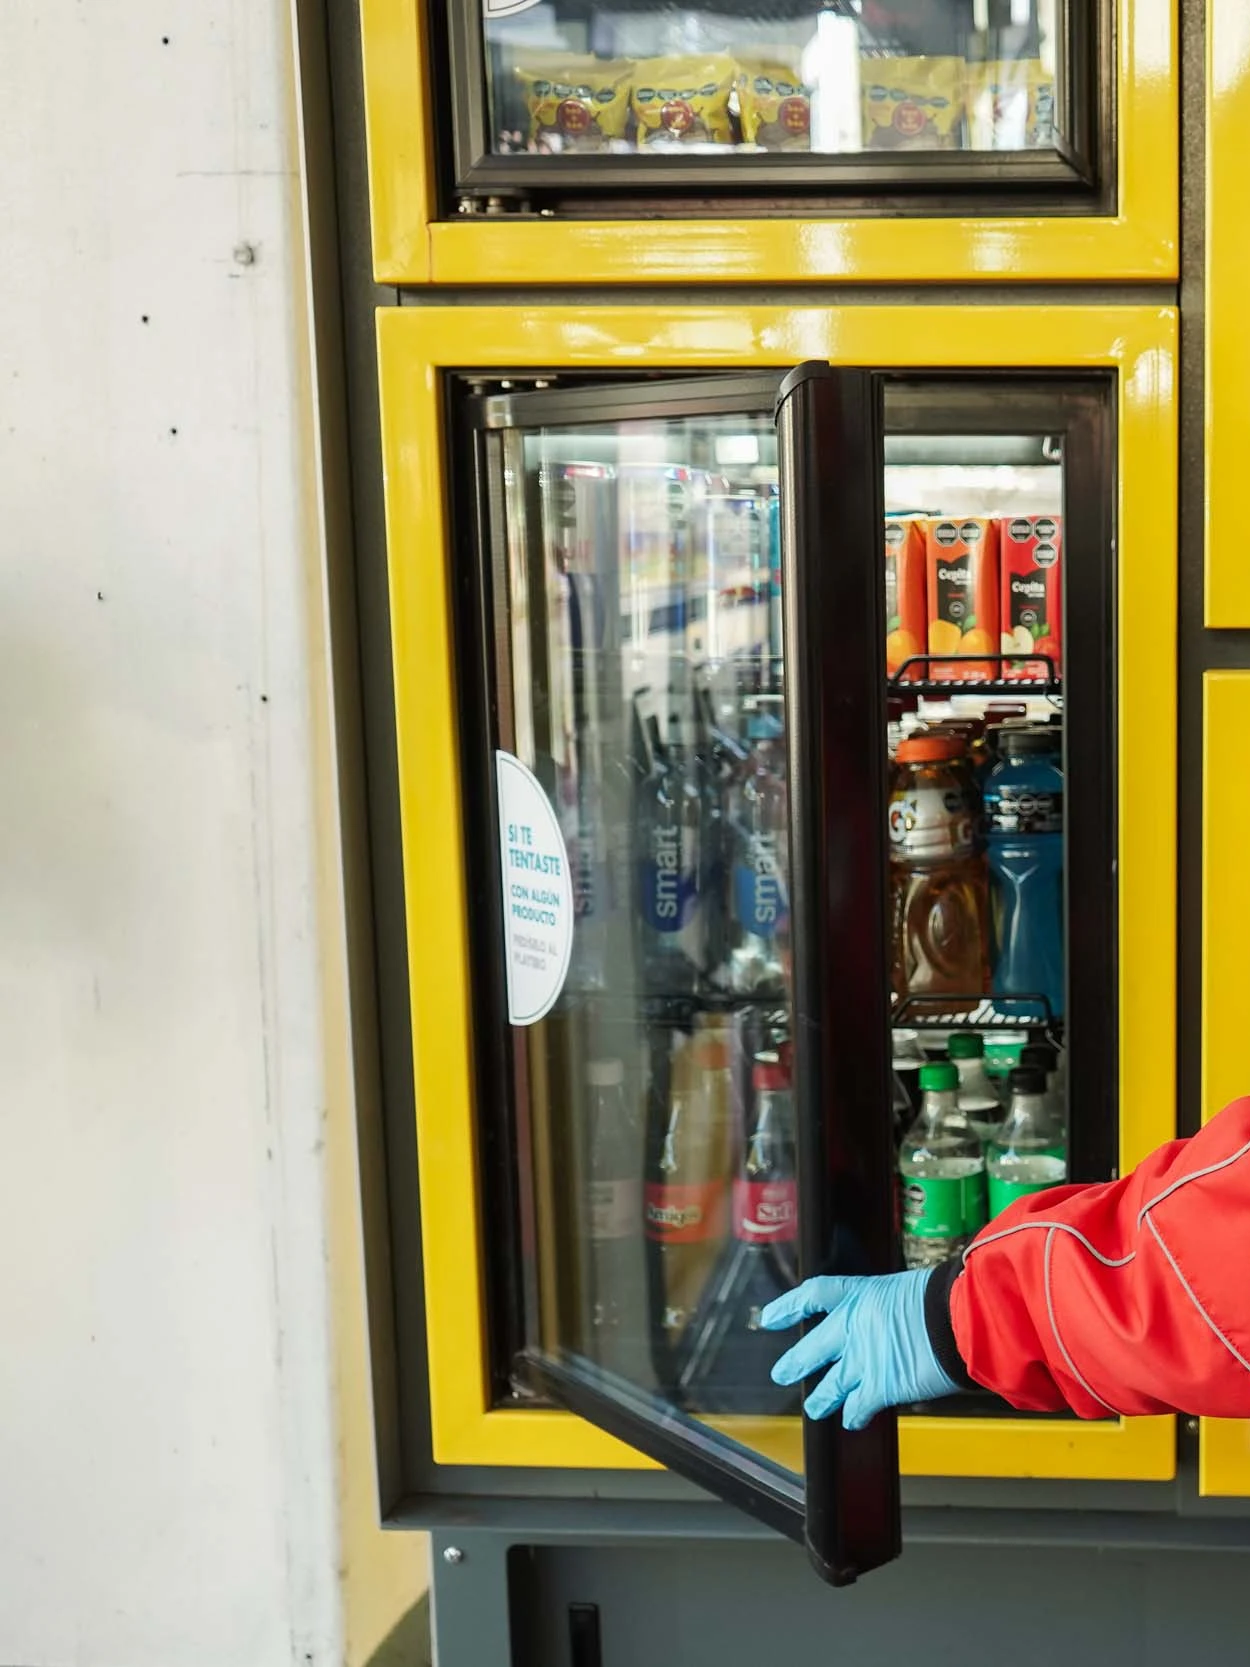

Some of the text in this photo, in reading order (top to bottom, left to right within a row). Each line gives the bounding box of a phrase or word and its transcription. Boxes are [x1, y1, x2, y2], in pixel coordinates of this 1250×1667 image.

[508, 824, 533, 845] SI TE
[509, 848, 561, 876] TENTASTE
[653, 824, 677, 918] smart
[753, 830, 776, 923] smart
[511, 884, 529, 900] CON
[512, 903, 556, 926] PRODUCTO
